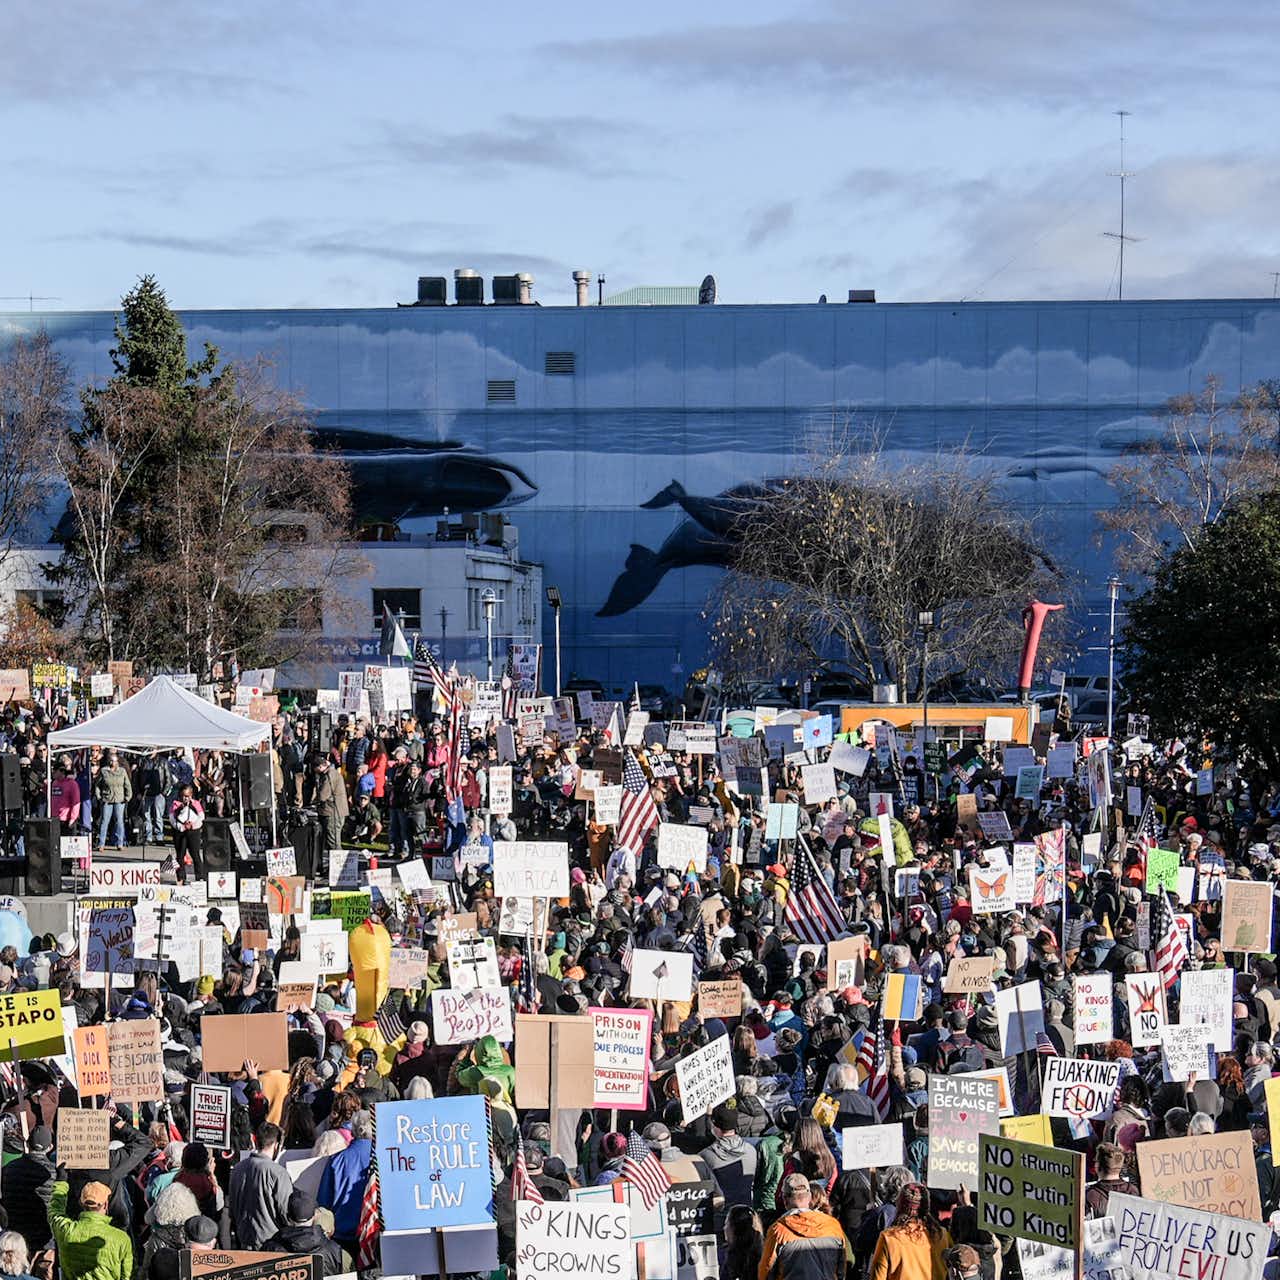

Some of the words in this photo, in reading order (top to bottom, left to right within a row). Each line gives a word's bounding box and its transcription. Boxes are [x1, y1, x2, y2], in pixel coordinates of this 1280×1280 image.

[91, 869, 114, 886] NO
[121, 868, 160, 887] KINGS
[141, 888, 155, 901] NO
[442, 919, 459, 930] NO
[957, 962, 970, 972] NO
[1078, 984, 1093, 994] NO
[26, 997, 39, 1007] IS
[1086, 997, 1110, 1005] KINGS
[594, 1015, 642, 1031] PRISON
[1141, 1014, 1158, 1030] NO
[86, 1033, 95, 1045] NO
[596, 1031, 641, 1043] WITHOUT
[1142, 1032, 1160, 1040] KINGS
[593, 1041, 612, 1052] DUE
[613, 1043, 645, 1056] PROCESS
[82, 1052, 99, 1065] DICK
[609, 1055, 618, 1065] IS
[622, 1057, 630, 1066] A
[81, 1071, 109, 1086] TATORS
[1047, 1060, 1118, 1087] FUAX-KING
[604, 1082, 631, 1092] CAMP
[932, 1078, 958, 1092] I'M
[960, 1080, 994, 1098] HERE
[198, 1094, 224, 1105] TRUE
[933, 1092, 997, 1113] BECAUSE
[1051, 1087, 1109, 1113] FELON
[198, 1104, 224, 1113] PATRIOTS
[396, 1114, 471, 1145] Restore
[932, 1137, 965, 1154] SAVE
[385, 1147, 416, 1172] The
[429, 1141, 482, 1170] RULE
[984, 1143, 1015, 1168] NO
[1020, 1150, 1075, 1179] tRump!
[1150, 1145, 1244, 1178] DEMOCRACY
[429, 1169, 442, 1182] of
[414, 1182, 466, 1211] LAW
[984, 1172, 1015, 1198] NO
[1021, 1177, 1074, 1207] Putin!
[1181, 1178, 1214, 1201] NOT
[520, 1204, 543, 1230] NO
[546, 1209, 627, 1241] KINGS
[984, 1201, 1015, 1227] NO
[1021, 1206, 1074, 1245] King!
[1120, 1207, 1218, 1252] DELIVER
[1227, 1226, 1257, 1260] US
[192, 1253, 233, 1268] ArtSkills
[518, 1244, 536, 1263] NO
[533, 1251, 621, 1275] CROWNS
[1120, 1234, 1174, 1272] FROM
[242, 1268, 264, 1278] WHITE
